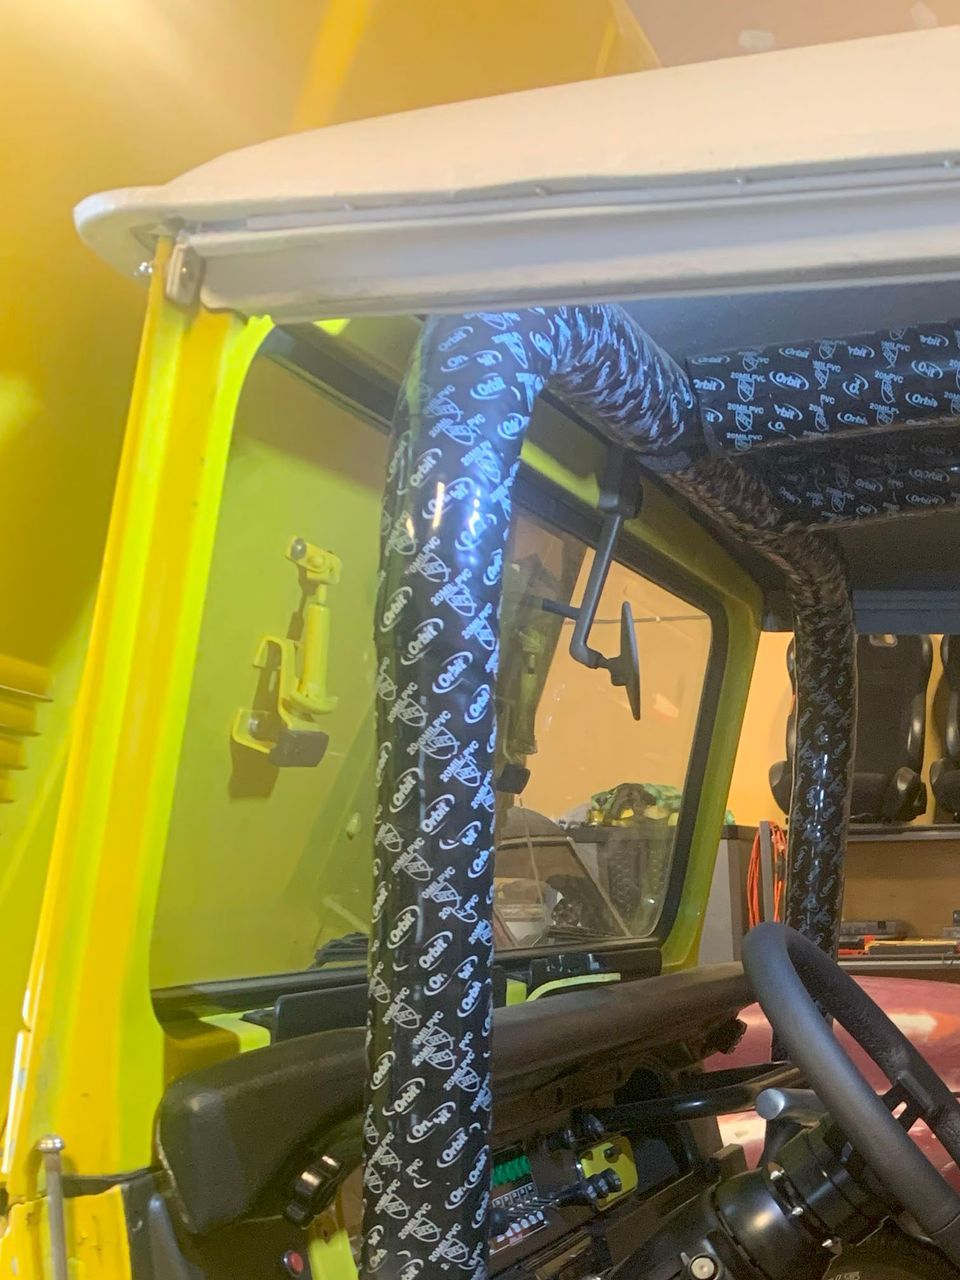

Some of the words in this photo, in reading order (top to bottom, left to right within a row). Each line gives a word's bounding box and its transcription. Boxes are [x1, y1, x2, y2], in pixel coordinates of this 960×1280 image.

[785, 348, 809, 358] Orbit
[477, 377, 506, 395] Orbit
[775, 373, 802, 388] Orbit
[411, 455, 436, 486] Orbit
[855, 479, 878, 491] Orbit
[384, 593, 408, 624] Orbit
[408, 623, 438, 654] Orbit
[438, 657, 467, 687] Orbit
[393, 773, 416, 806] Orbit
[422, 801, 450, 832] Orbit
[391, 911, 416, 942] Orbit
[419, 937, 448, 968] Orbit
[462, 981, 481, 1009] Orbit
[373, 1058, 391, 1084] Orbit
[394, 1083, 420, 1112] Orbit
[442, 1130, 468, 1161] Orbit
[470, 1153, 487, 1181] Orbit
